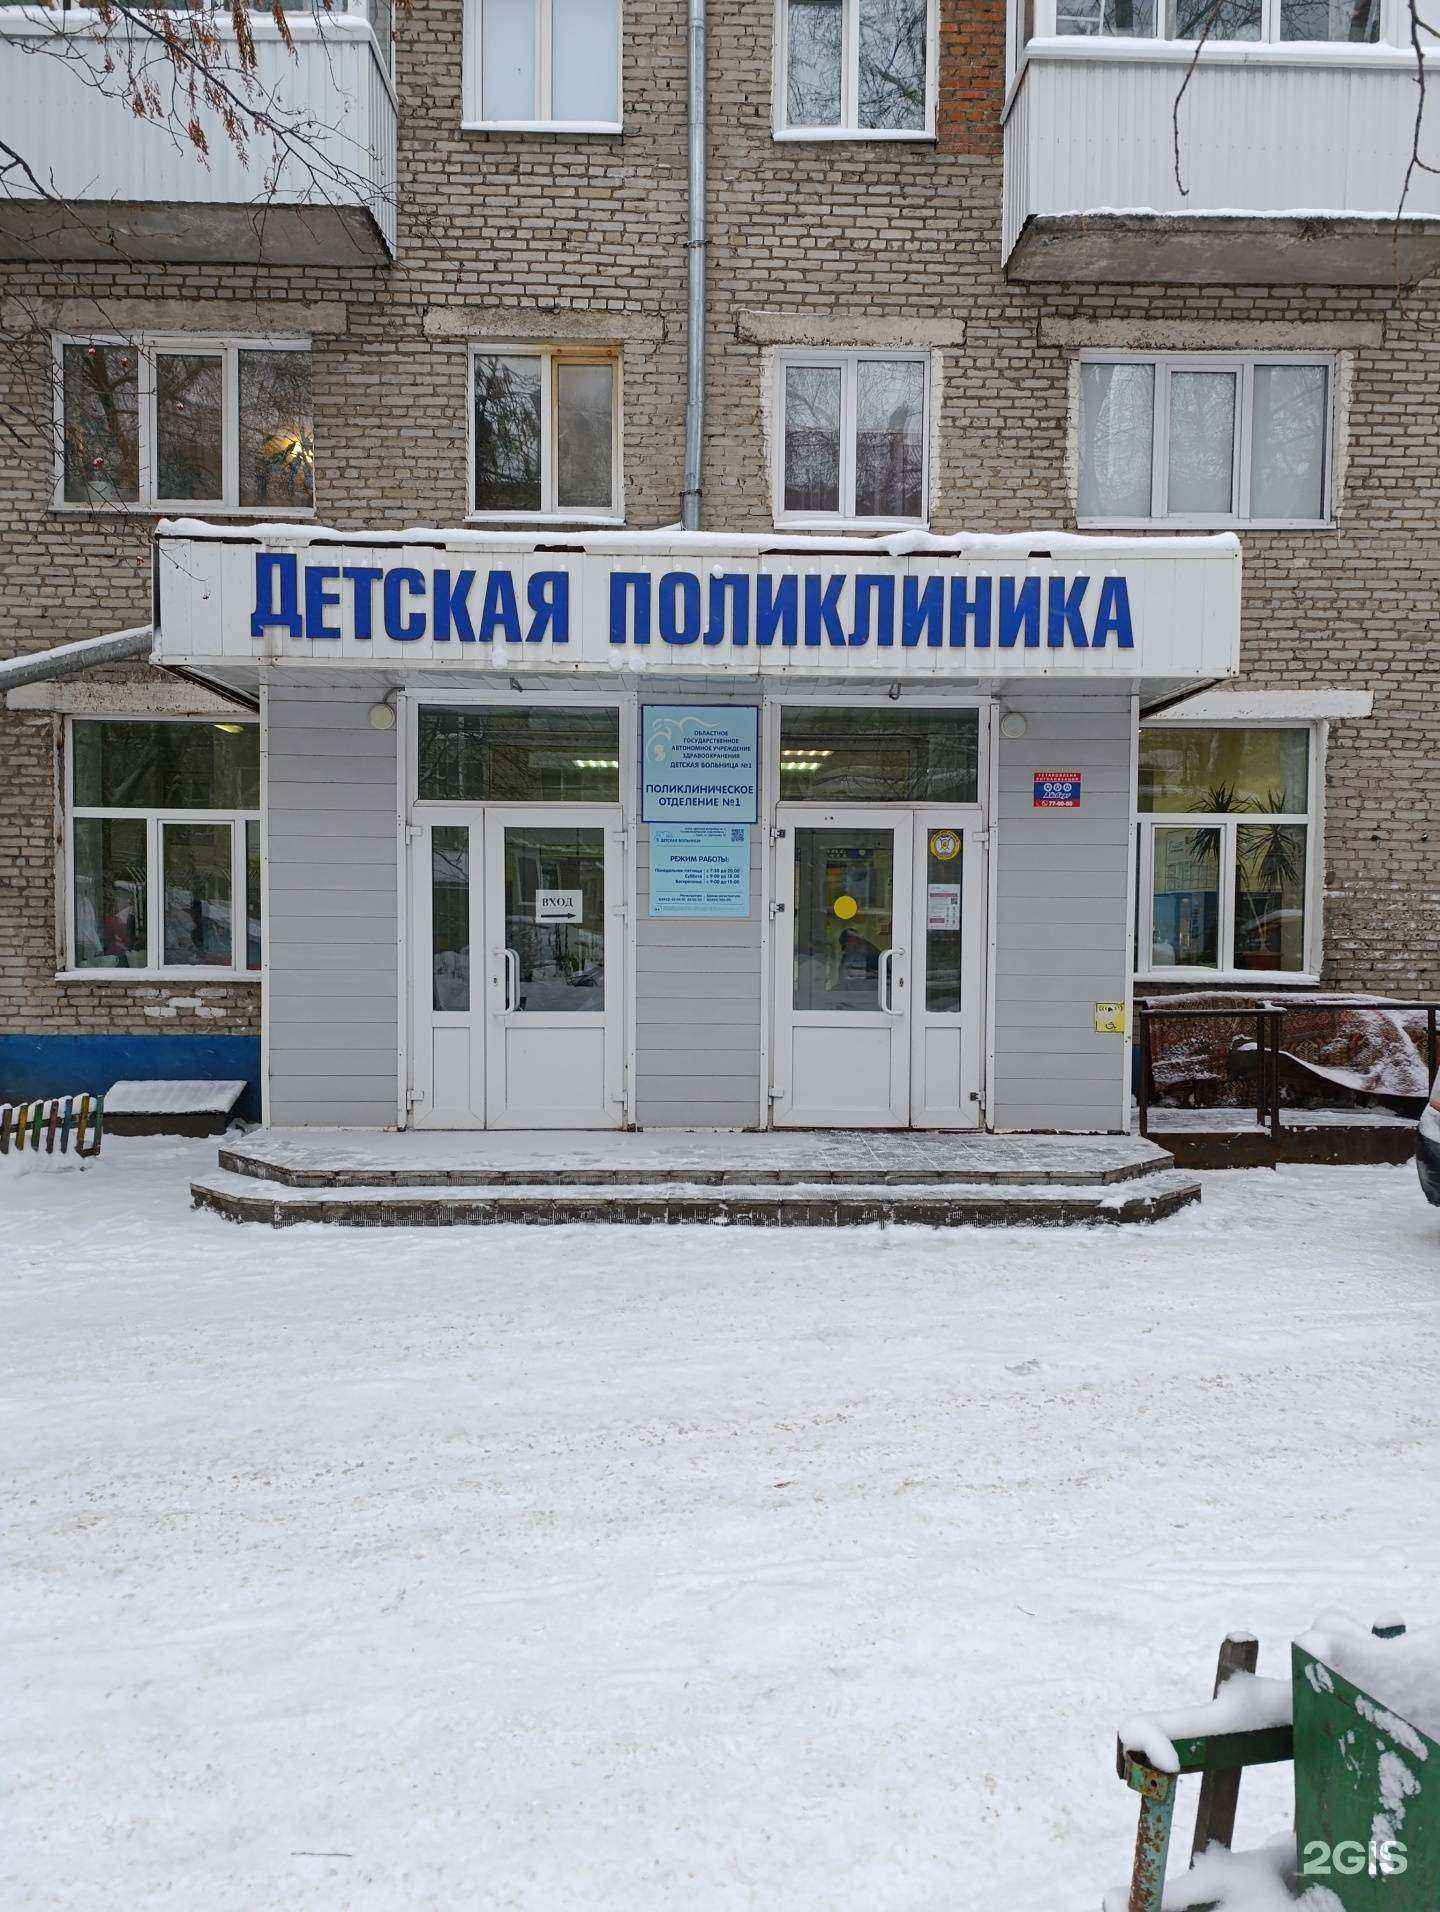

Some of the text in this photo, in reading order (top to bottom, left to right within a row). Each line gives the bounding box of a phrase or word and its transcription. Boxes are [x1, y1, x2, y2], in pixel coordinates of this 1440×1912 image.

[250, 553, 1134, 648] ДЕТСКАЯ ПОЛИКЛИНИКА
[646, 784, 754, 794] ПОЛИКЛИНИЧЕСКОЕ
[658, 798, 740, 807] ОТДЕЛЕНИЕ №1
[542, 898, 574, 907] ВХОД
